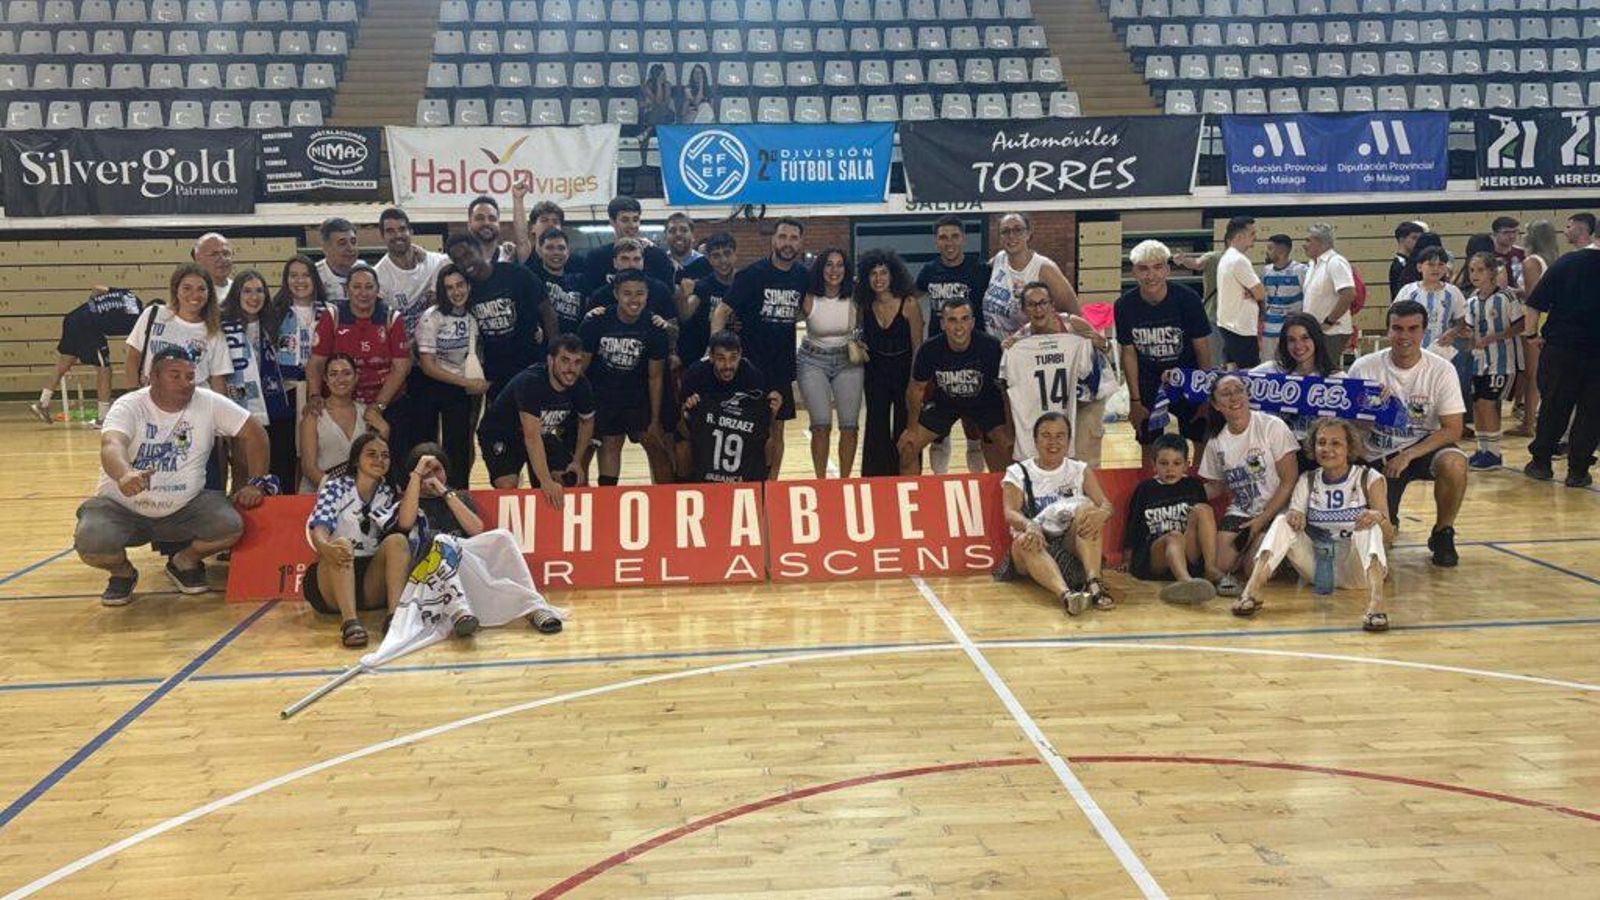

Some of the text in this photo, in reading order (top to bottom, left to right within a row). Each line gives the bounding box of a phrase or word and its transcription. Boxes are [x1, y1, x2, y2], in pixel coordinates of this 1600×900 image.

[991, 126, 1120, 152] Automóviles
[311, 143, 364, 160] NIMAC
[780, 147, 873, 158] DIVISIÓN
[20, 148, 238, 198] Silvergold
[780, 158, 874, 182] FÚTBOL SALA
[972, 155, 1137, 193] TORRES
[1284, 163, 1328, 173] Provincial
[1389, 161, 1435, 172] Provincial
[535, 173, 598, 199] viajes
[1257, 175, 1269, 184] de
[1480, 176, 1544, 187] HEREDIA
[175, 186, 238, 196] Patrimonio
[764, 287, 797, 307] SOMOS
[454, 321, 467, 336] 19
[1132, 326, 1173, 344] SOMOS
[360, 341, 371, 352] 15
[1035, 353, 1065, 366] TURBI
[1034, 368, 1069, 411] 14
[1489, 375, 1505, 389] 10
[719, 416, 755, 433] ORZAEZ
[712, 429, 744, 473] 19
[1325, 489, 1345, 509] 19
